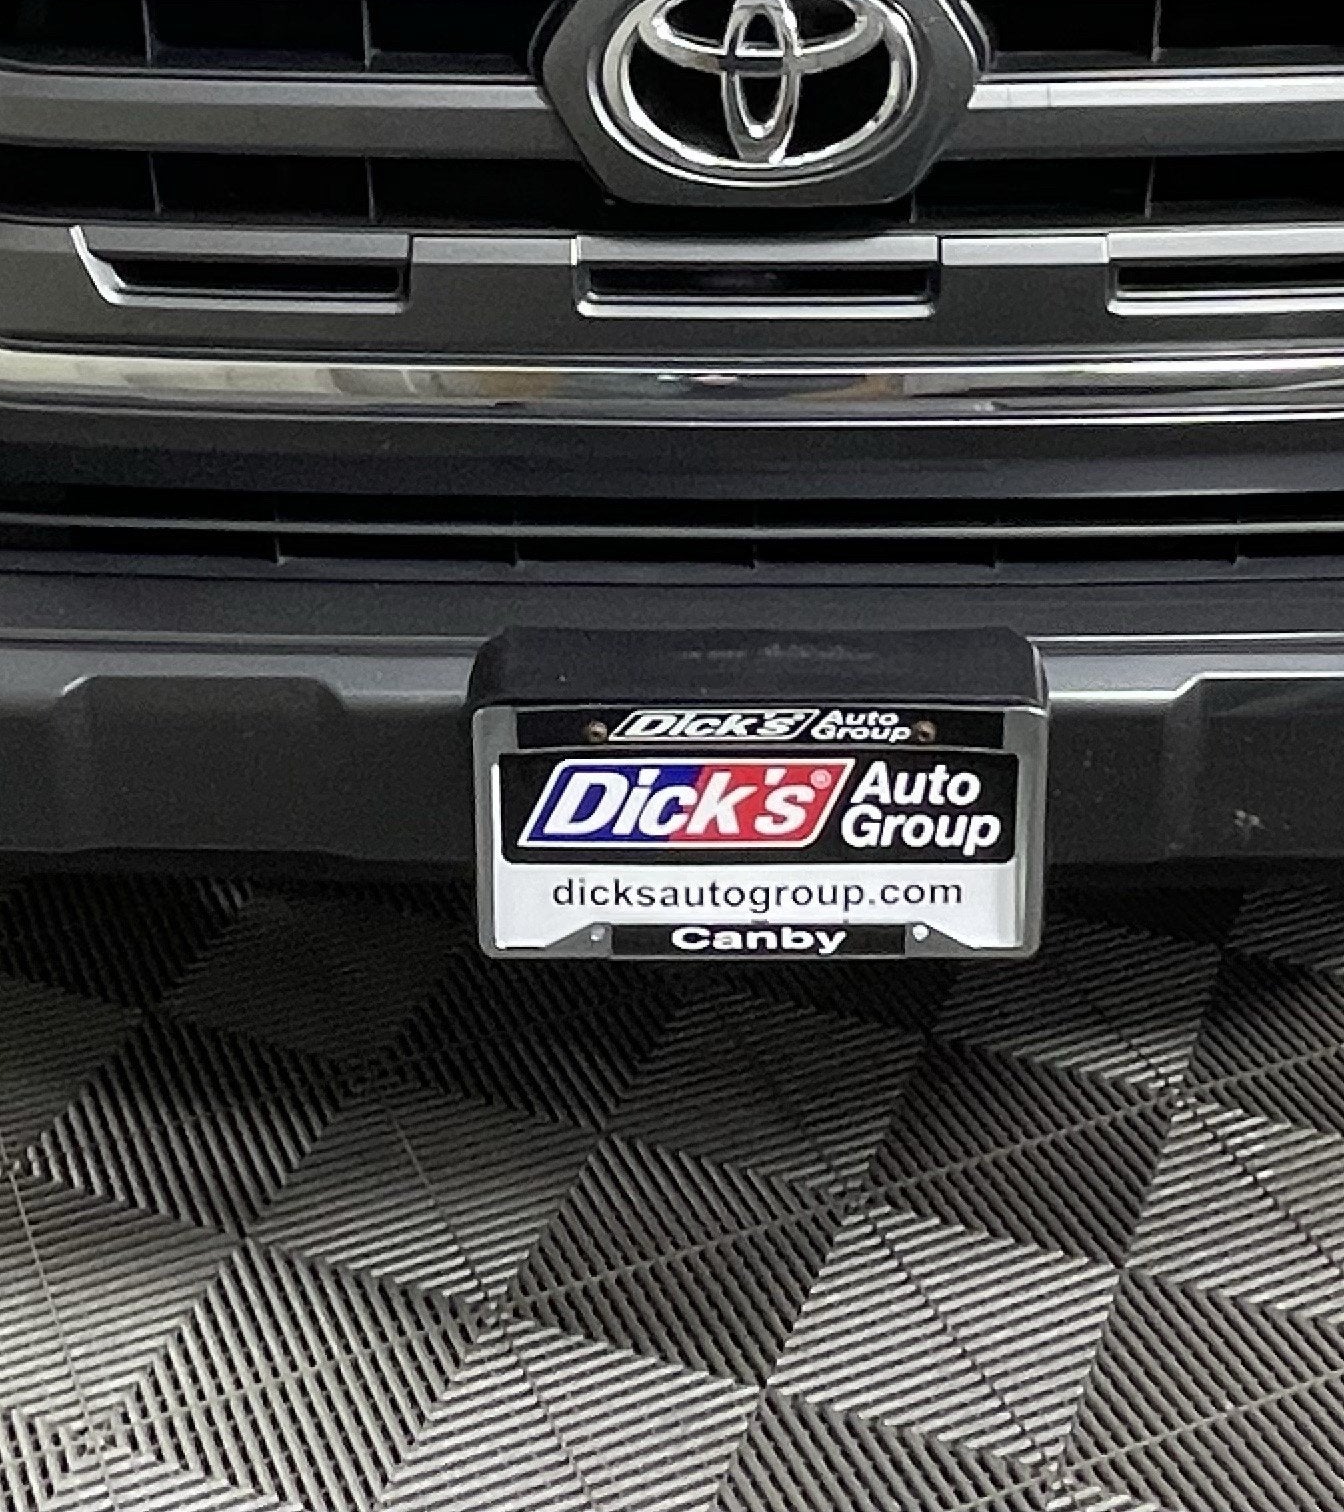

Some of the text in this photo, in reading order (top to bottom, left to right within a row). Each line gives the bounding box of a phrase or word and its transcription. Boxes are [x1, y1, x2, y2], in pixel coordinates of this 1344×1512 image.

[823, 710, 900, 726] Auto
[810, 724, 912, 744] Group
[851, 761, 981, 806] Auto
[840, 809, 1002, 855] Group
[552, 878, 963, 913] dicksautogroup.com
[671, 926, 848, 954] Canby
